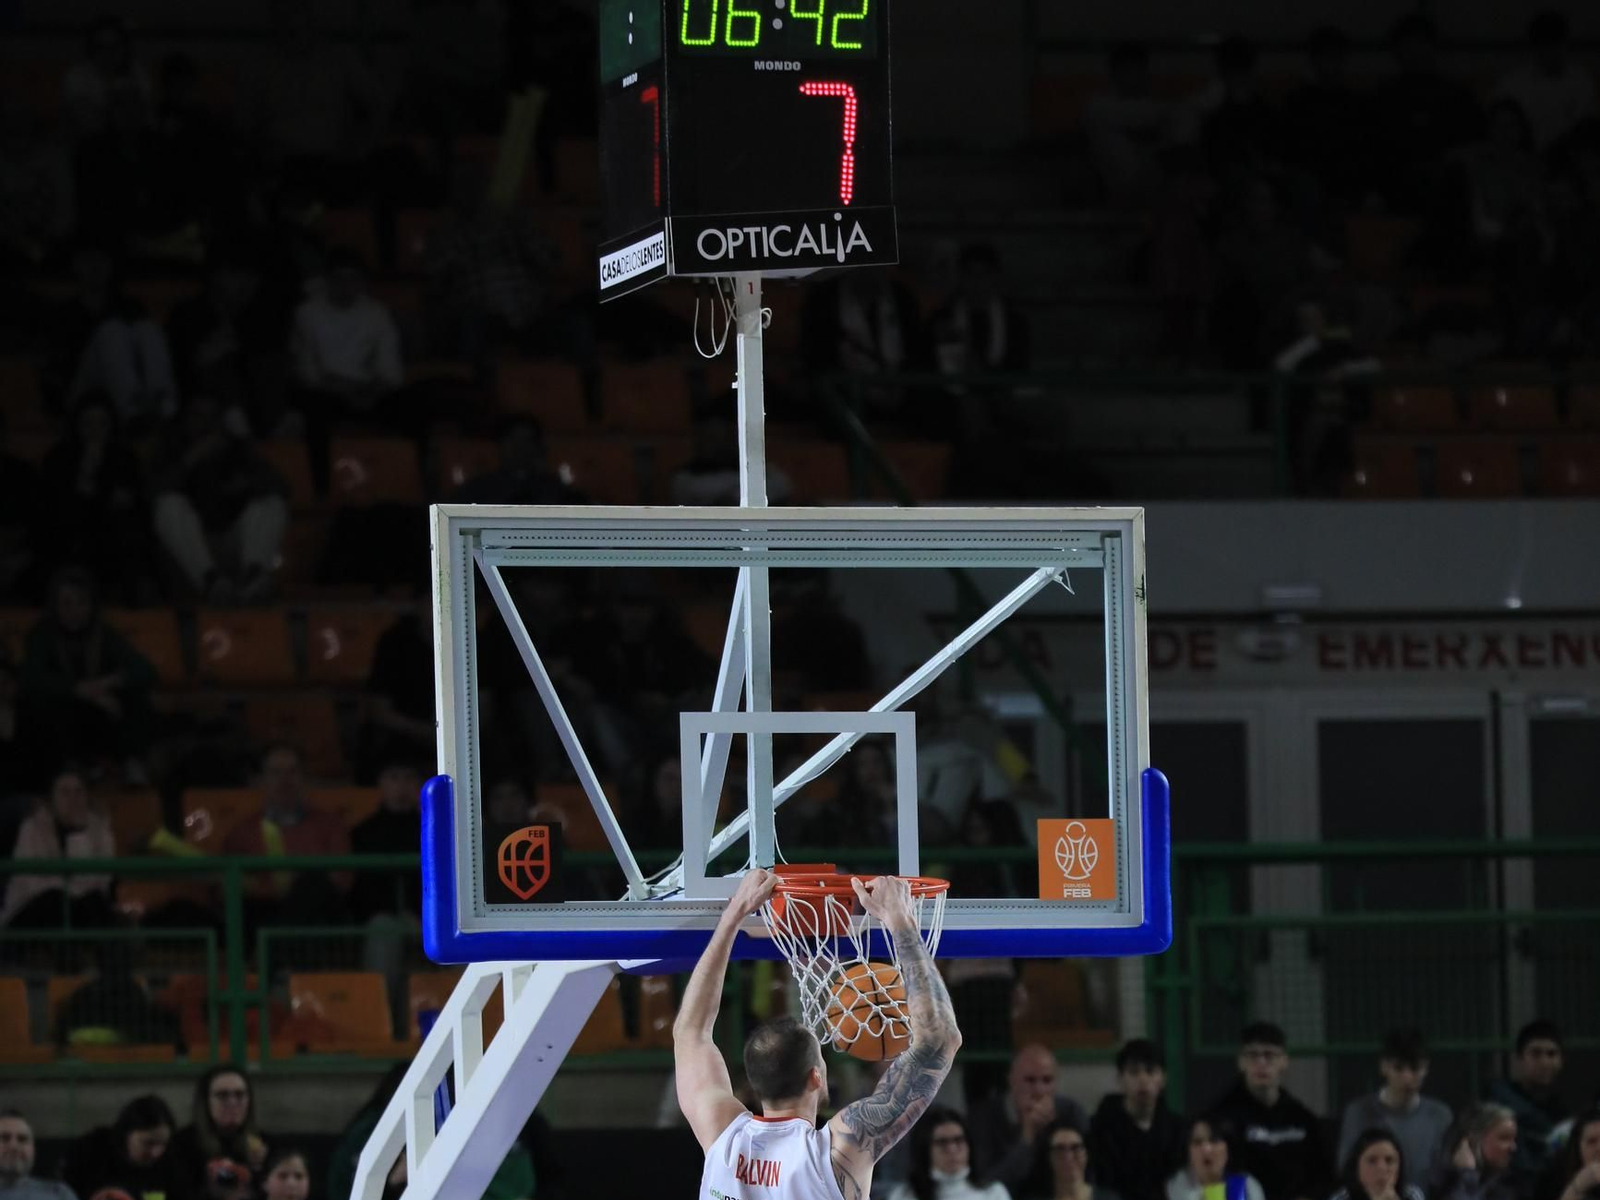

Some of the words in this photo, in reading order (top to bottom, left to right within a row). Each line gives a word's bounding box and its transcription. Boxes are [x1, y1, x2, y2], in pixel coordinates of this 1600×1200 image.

[681, 0, 868, 49] 06:42
[754, 60, 801, 71] MONDO
[800, 82, 857, 206] 7
[1149, 629, 1218, 670] DE
[528, 830, 545, 838] FEB
[1063, 888, 1092, 898] FEB
[736, 1153, 782, 1187] BALVIN
